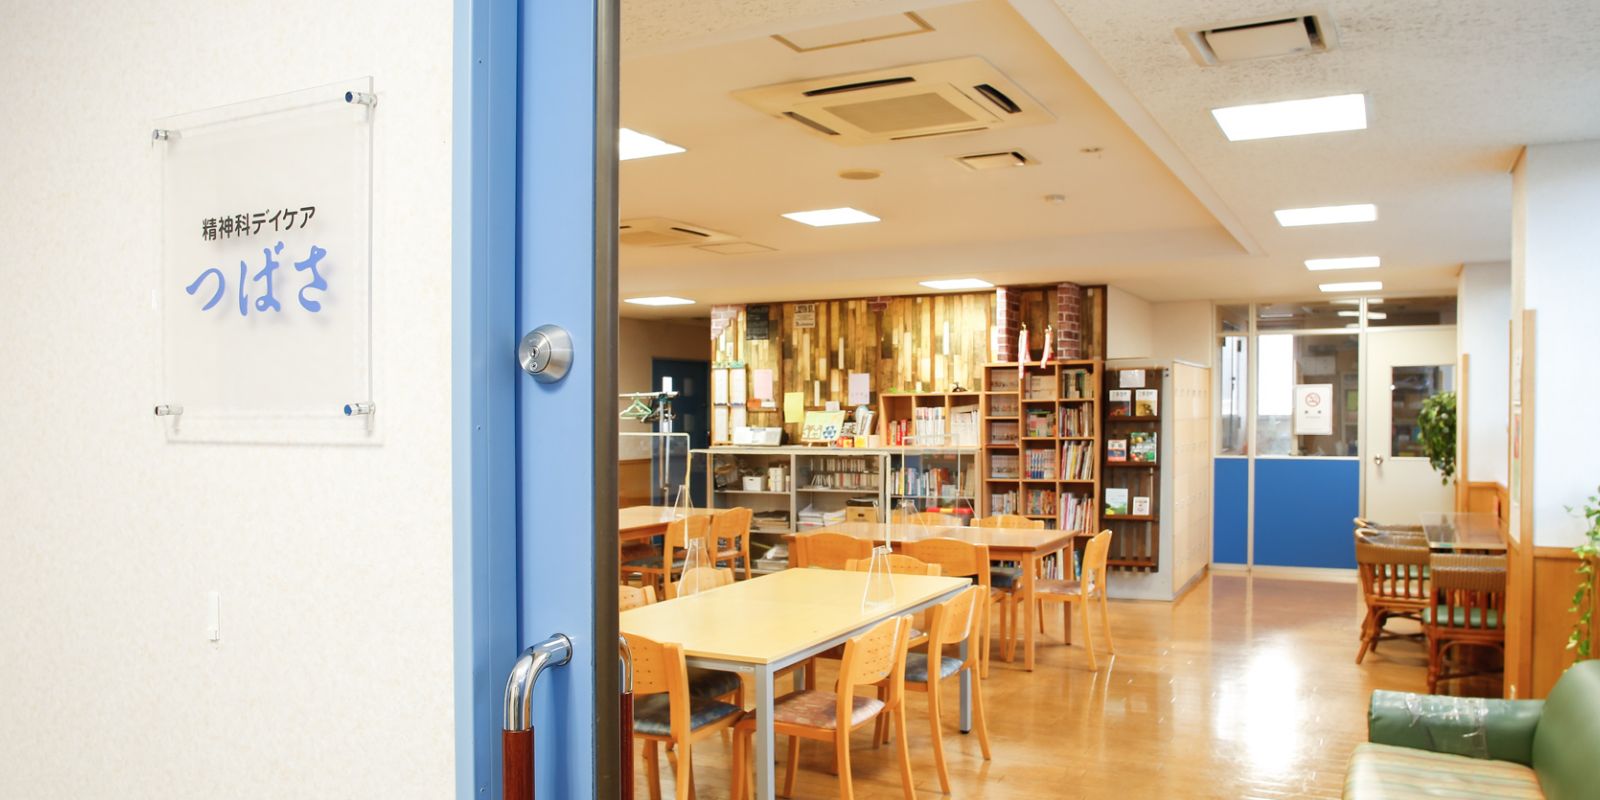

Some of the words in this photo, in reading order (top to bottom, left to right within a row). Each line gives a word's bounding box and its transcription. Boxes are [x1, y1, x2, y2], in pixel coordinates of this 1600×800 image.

[202, 206, 316, 241] 精神科デイケア
[186, 241, 328, 316] つばさ
